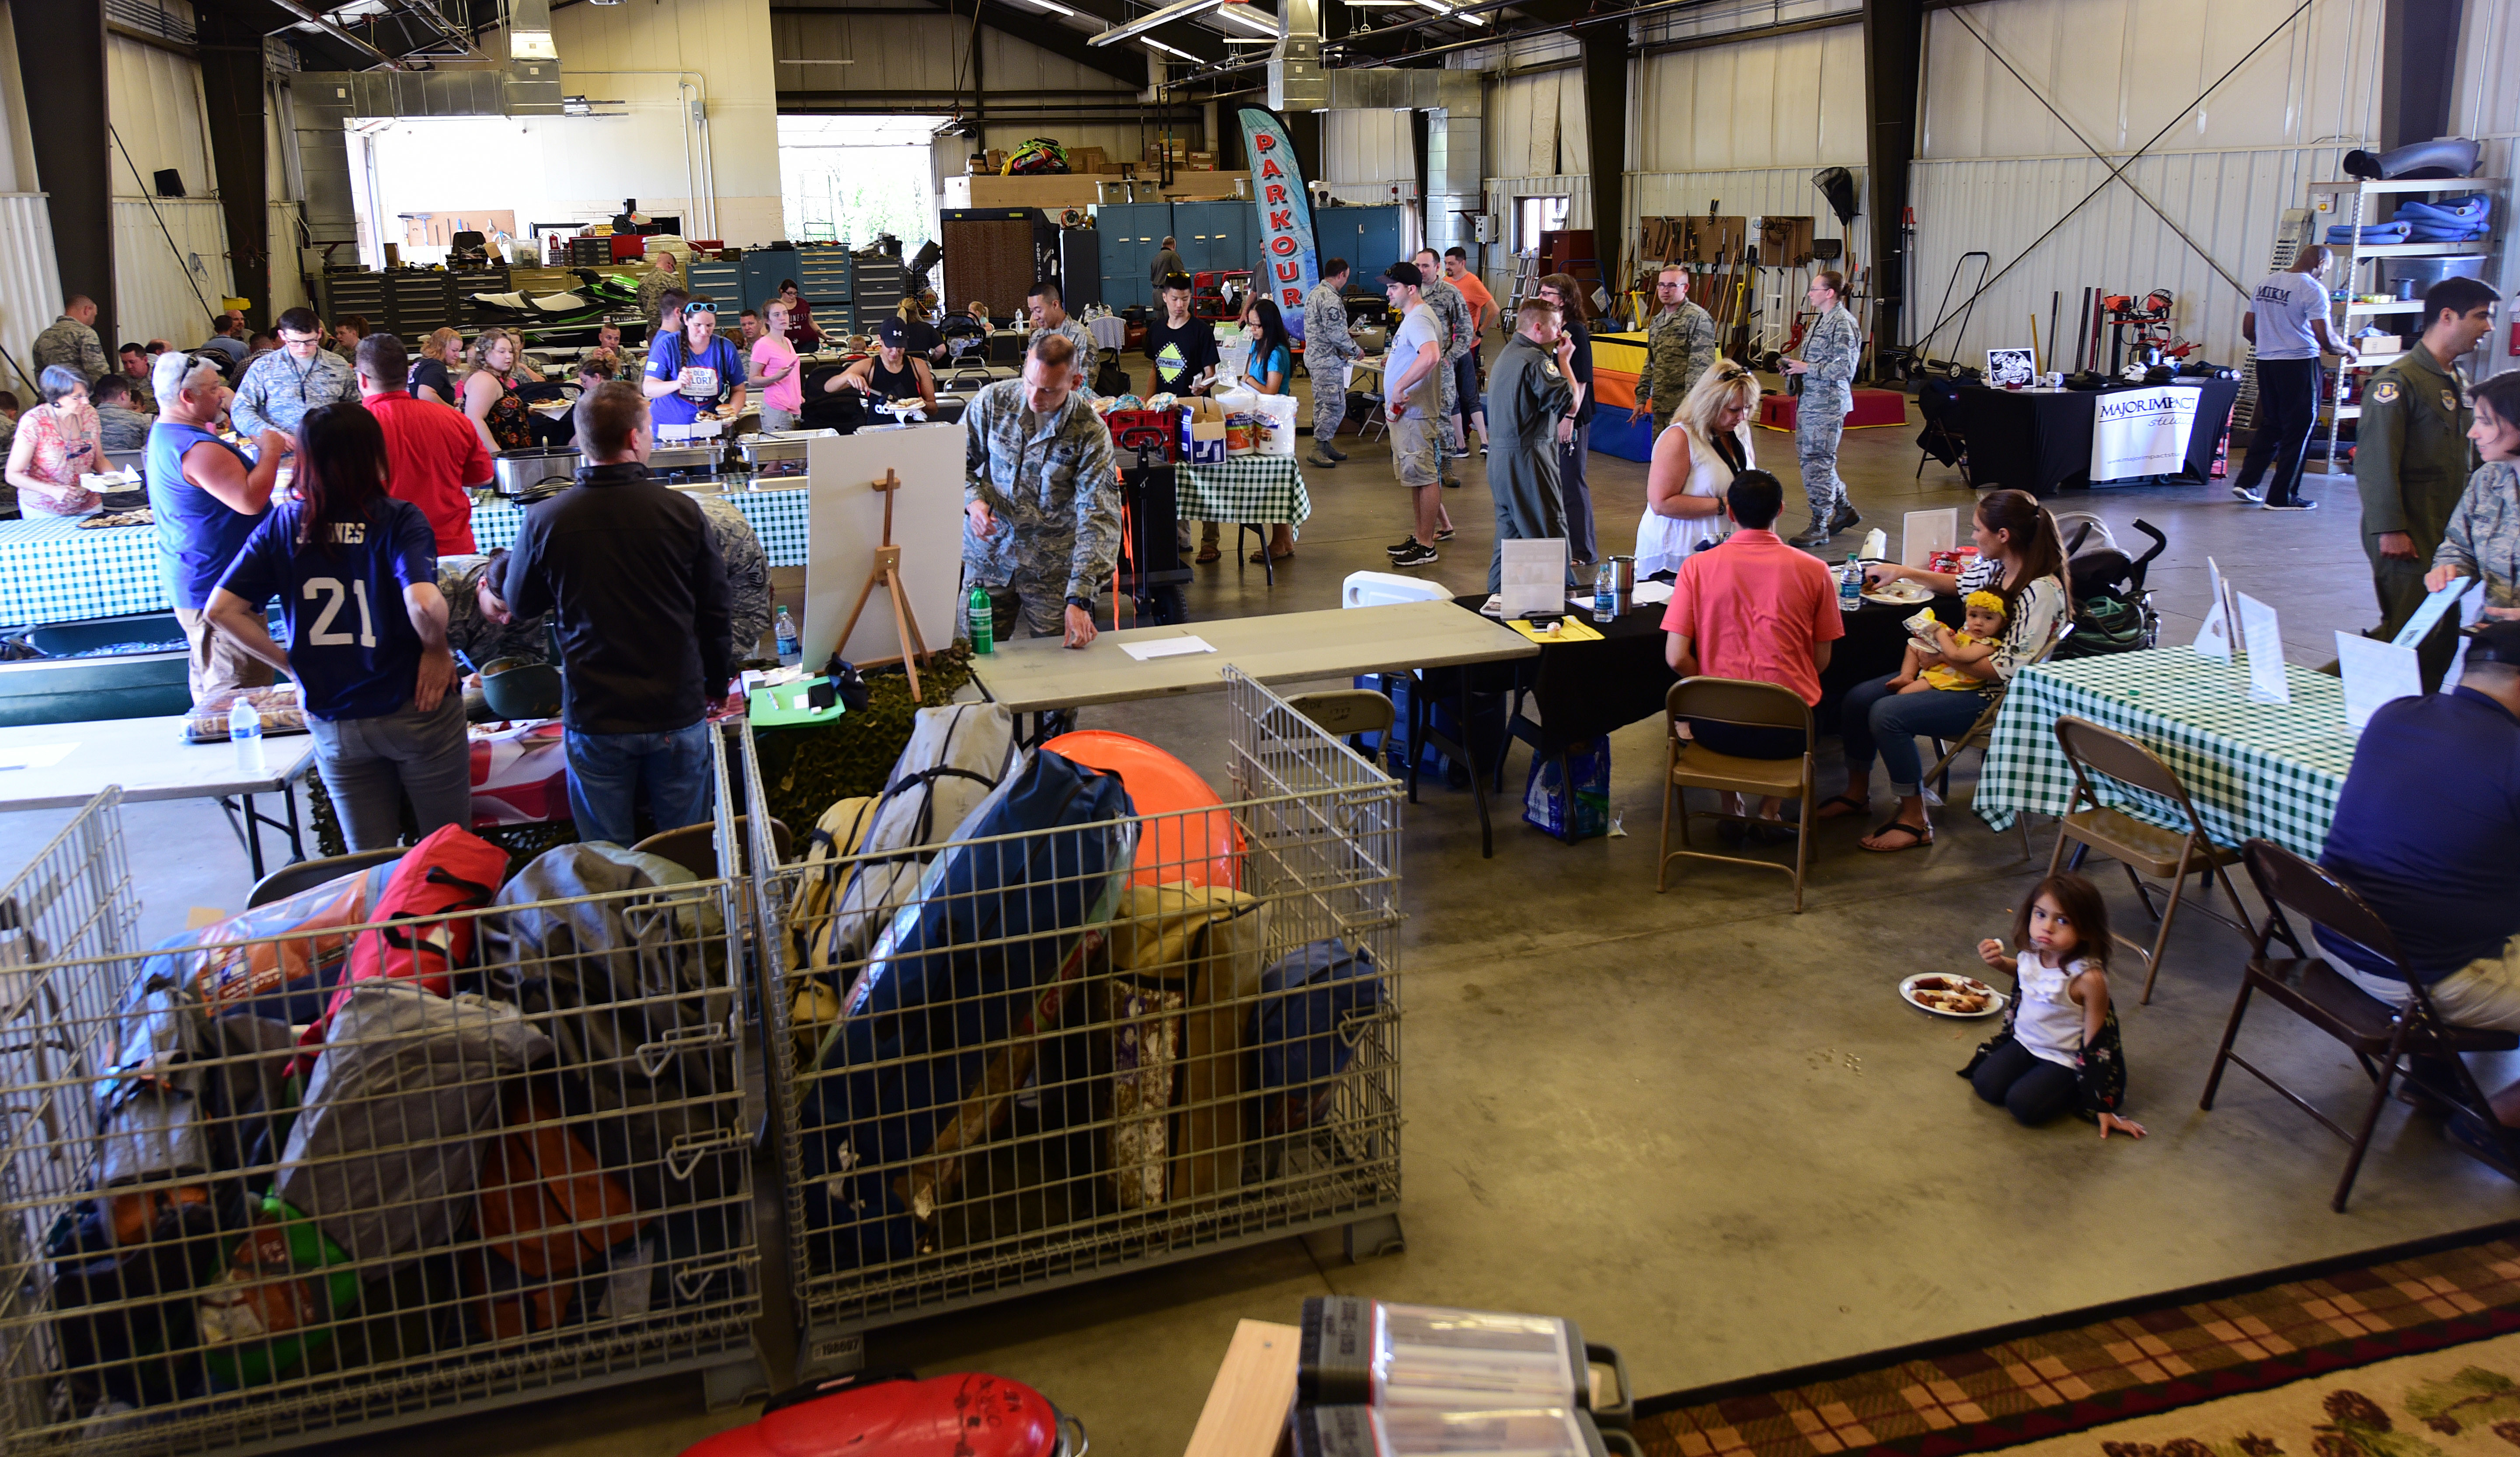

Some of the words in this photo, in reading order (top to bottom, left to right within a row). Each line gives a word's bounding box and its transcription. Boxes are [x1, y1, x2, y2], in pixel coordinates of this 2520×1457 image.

[1255, 133, 1305, 307] PARKOUR
[790, 313, 807, 322] INESS
[2100, 400, 2148, 417] MAJOR
[2148, 397, 2196, 410] IMPACT
[302, 577, 376, 648] 21
